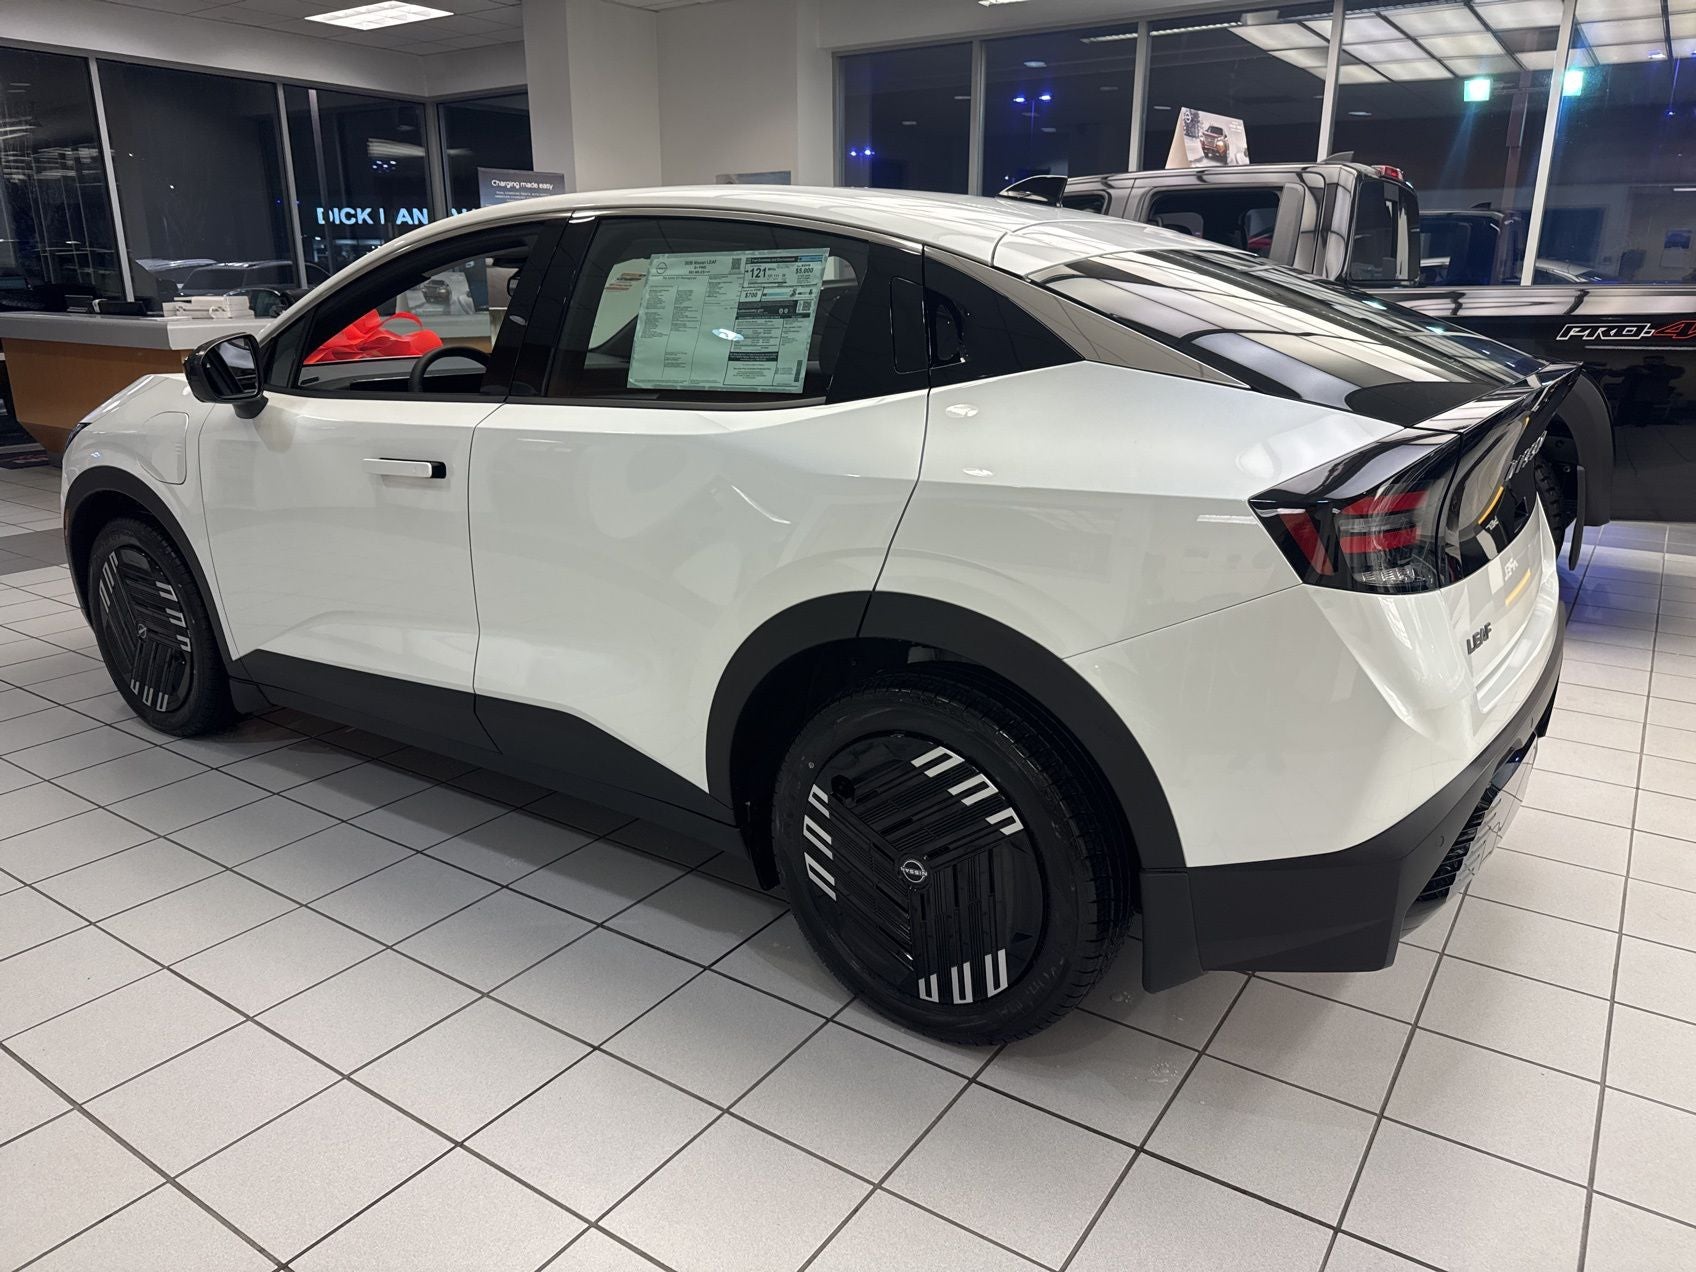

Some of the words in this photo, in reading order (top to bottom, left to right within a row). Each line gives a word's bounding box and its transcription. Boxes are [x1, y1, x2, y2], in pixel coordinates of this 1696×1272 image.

[491, 179, 520, 189] Charging
[520, 181, 538, 189] made
[539, 182, 554, 190] easy
[750, 267, 767, 279] 121
[1556, 320, 1696, 341] PRO-4
[1466, 621, 1492, 655] LEAF
